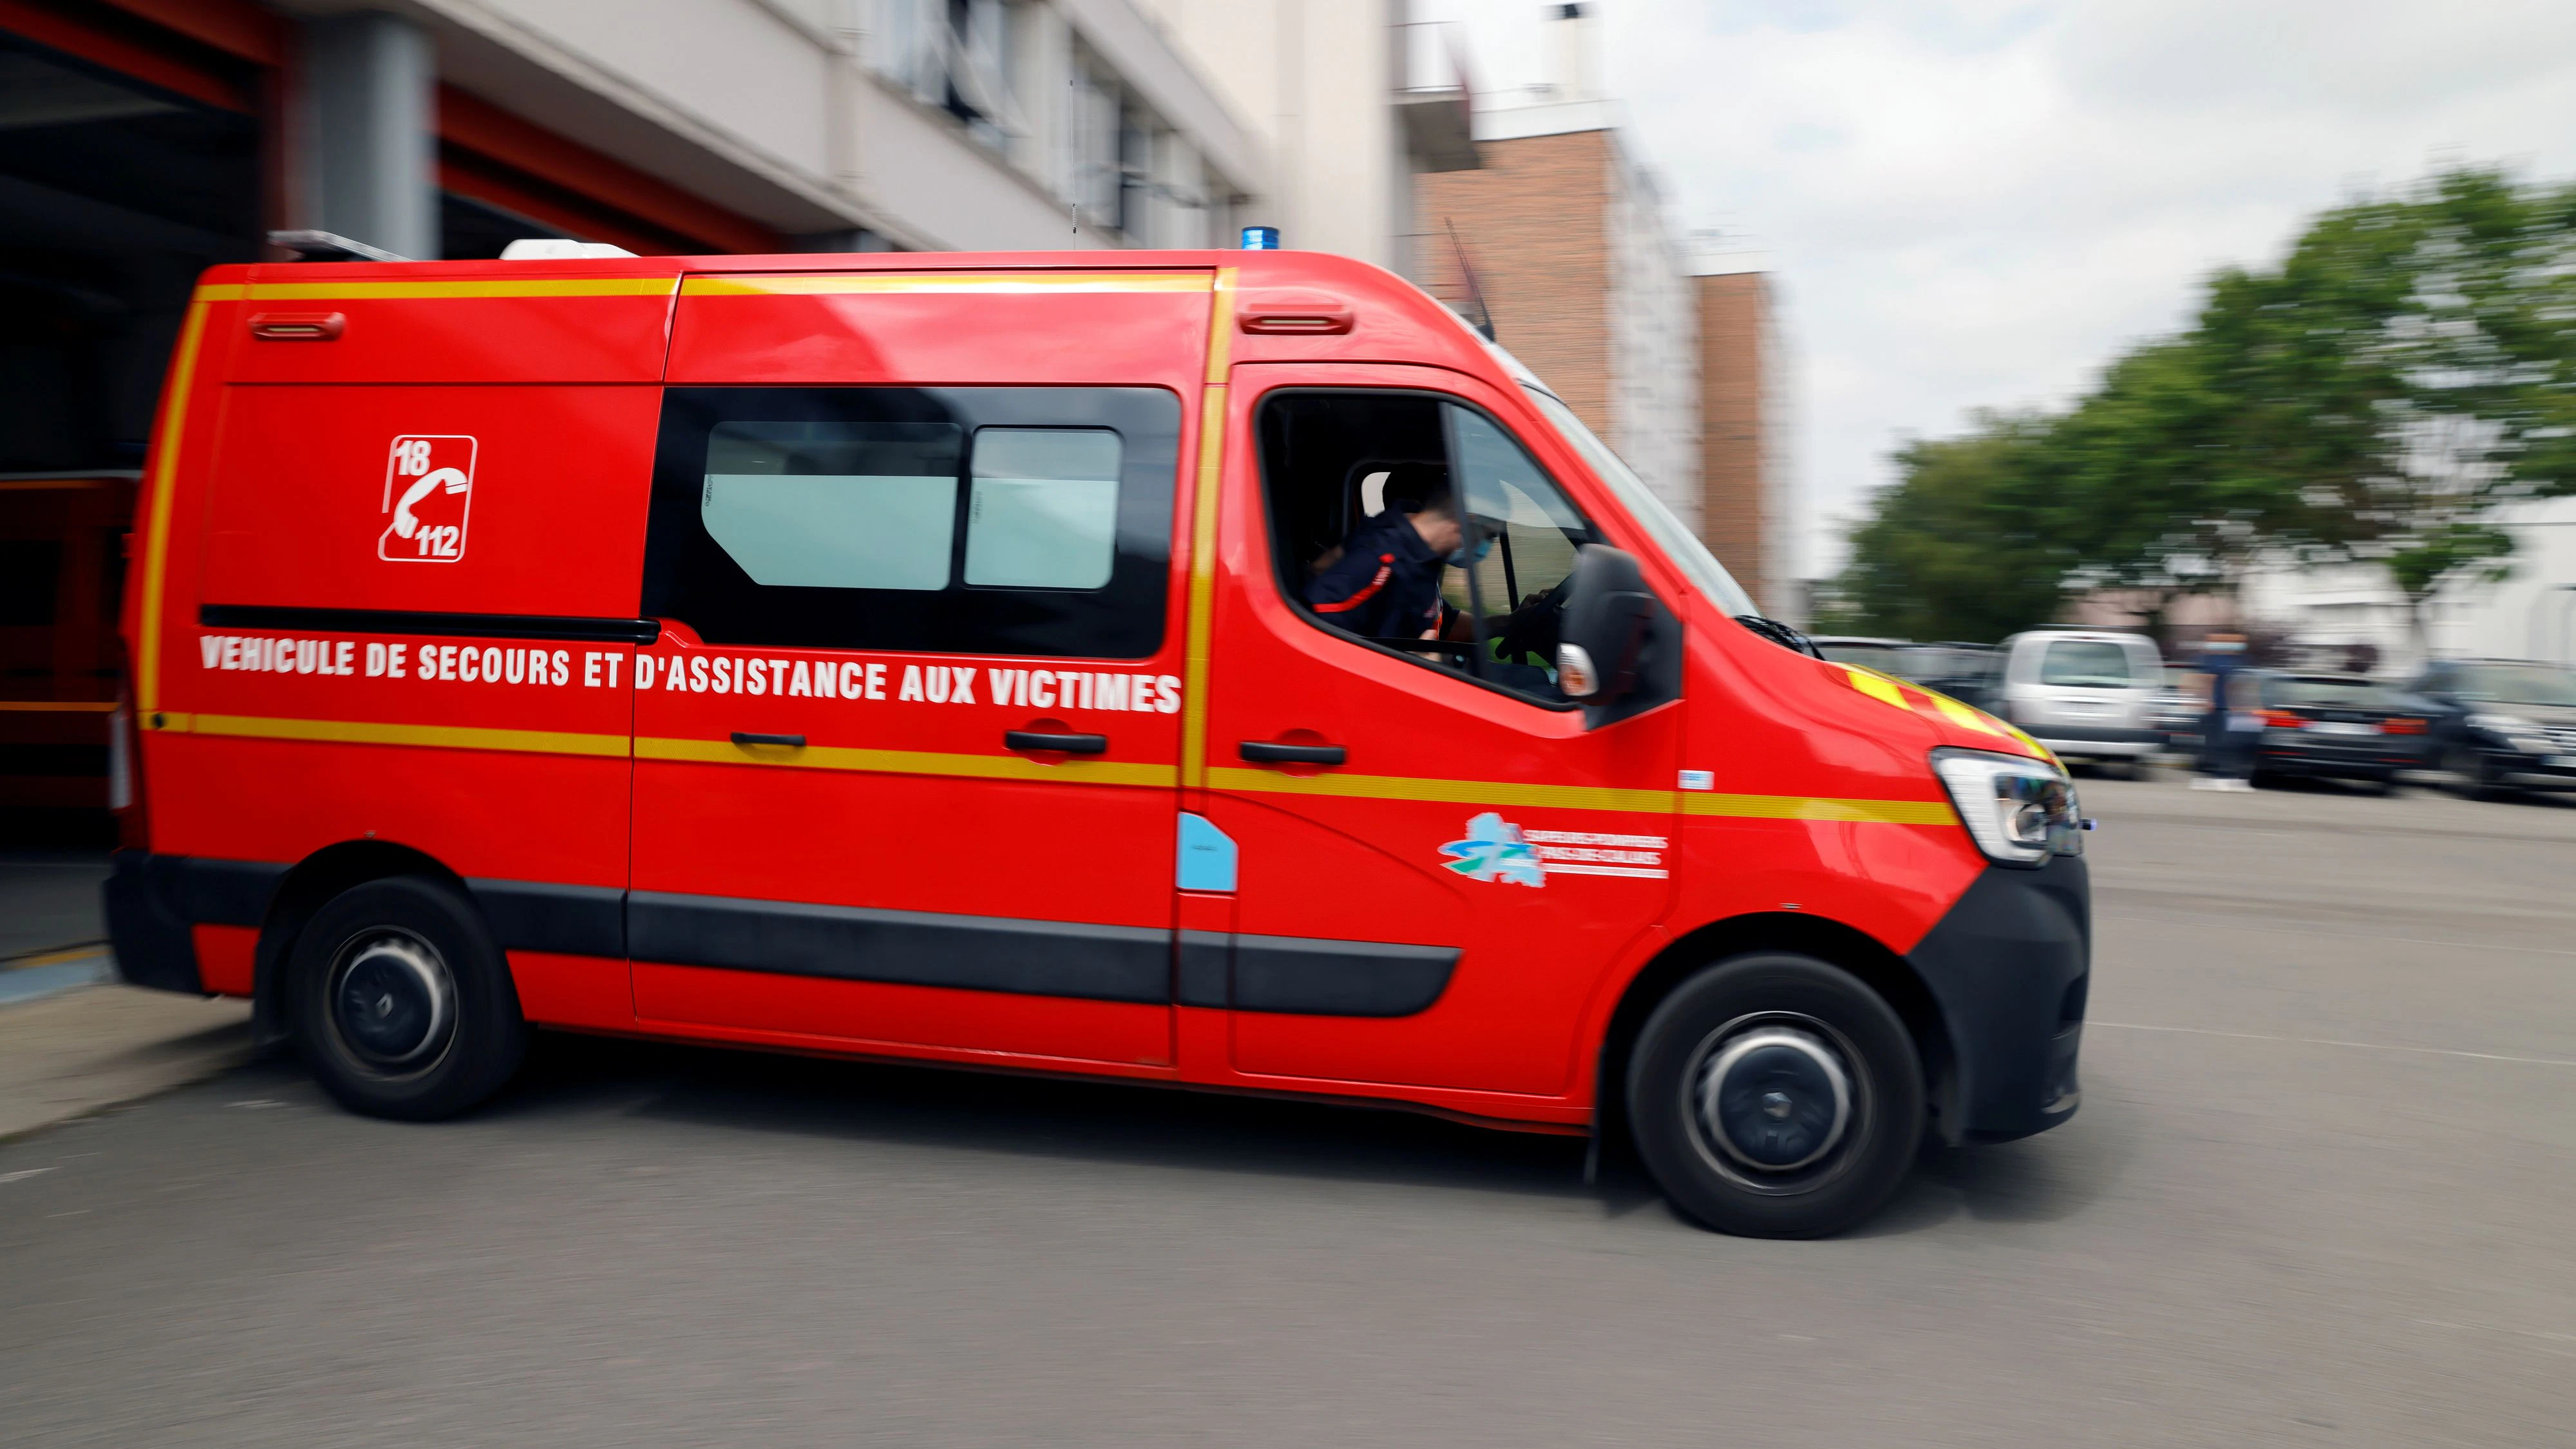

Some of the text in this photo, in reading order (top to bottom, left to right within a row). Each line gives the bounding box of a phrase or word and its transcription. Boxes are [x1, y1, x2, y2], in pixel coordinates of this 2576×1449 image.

[394, 440, 431, 476] 18
[415, 526, 459, 556] 112
[199, 634, 1182, 714] VEHICULE DE SECOURS ET D'ASSISTANCE AUX VICTIMES
